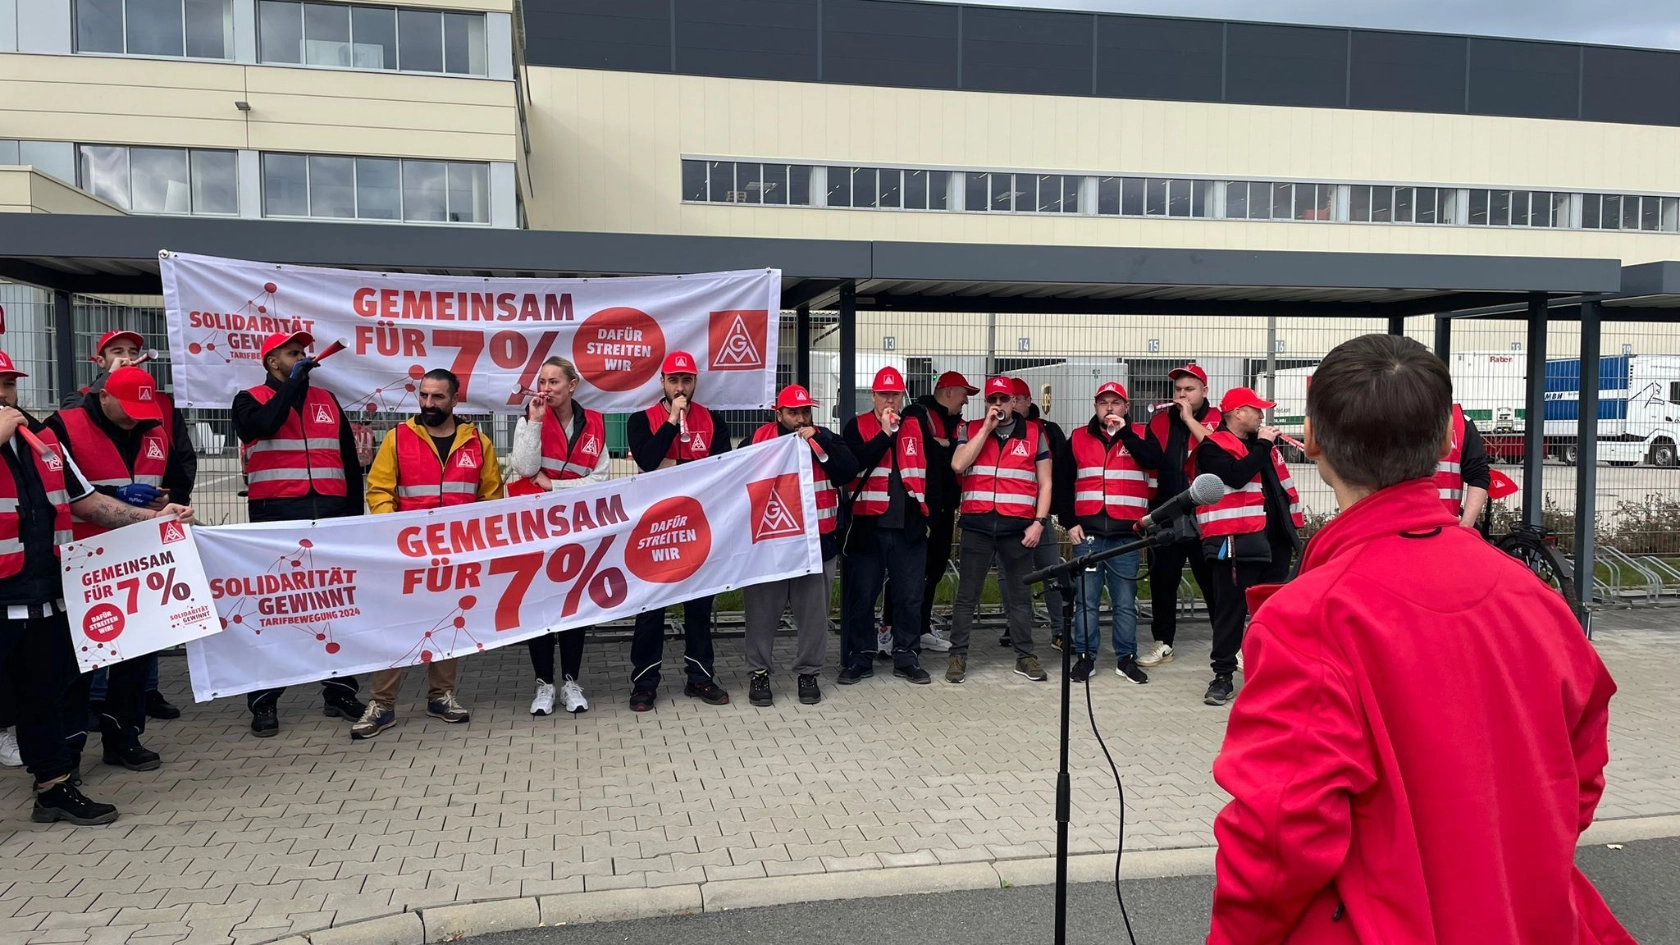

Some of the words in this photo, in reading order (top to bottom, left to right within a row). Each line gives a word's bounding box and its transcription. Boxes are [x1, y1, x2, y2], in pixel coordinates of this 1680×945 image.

[353, 287, 574, 322] GEMEINSAM
[189, 311, 315, 334] SOLIDARITÄT
[355, 320, 427, 357] FÜR
[597, 326, 643, 342] DAFÜR
[884, 338, 896, 350] 13
[586, 341, 652, 358] STREITEN
[1019, 339, 1029, 351] 14
[1149, 340, 1159, 351] 15
[604, 358, 632, 372] WIR
[397, 494, 630, 558] GEMEINSAM
[650, 514, 688, 534] DAFÜR
[637, 528, 697, 550] STREITEN
[651, 546, 681, 562] WIR
[81, 550, 175, 586] GEMEINSAM
[209, 567, 357, 599] SOLIDARITÄT
[402, 557, 481, 594] FÜR
[487, 534, 628, 632] 7%
[83, 583, 114, 604] FÜR
[258, 586, 357, 615] GEWINNT
[89, 615, 119, 631] STREITEN
[91, 610, 113, 623] DAFÜR
[169, 605, 209, 621] SOLIDARITÄT
[182, 610, 210, 623] GEWINNT
[259, 611, 338, 627] TARIFBEWEGUNG
[339, 607, 361, 619] 2024
